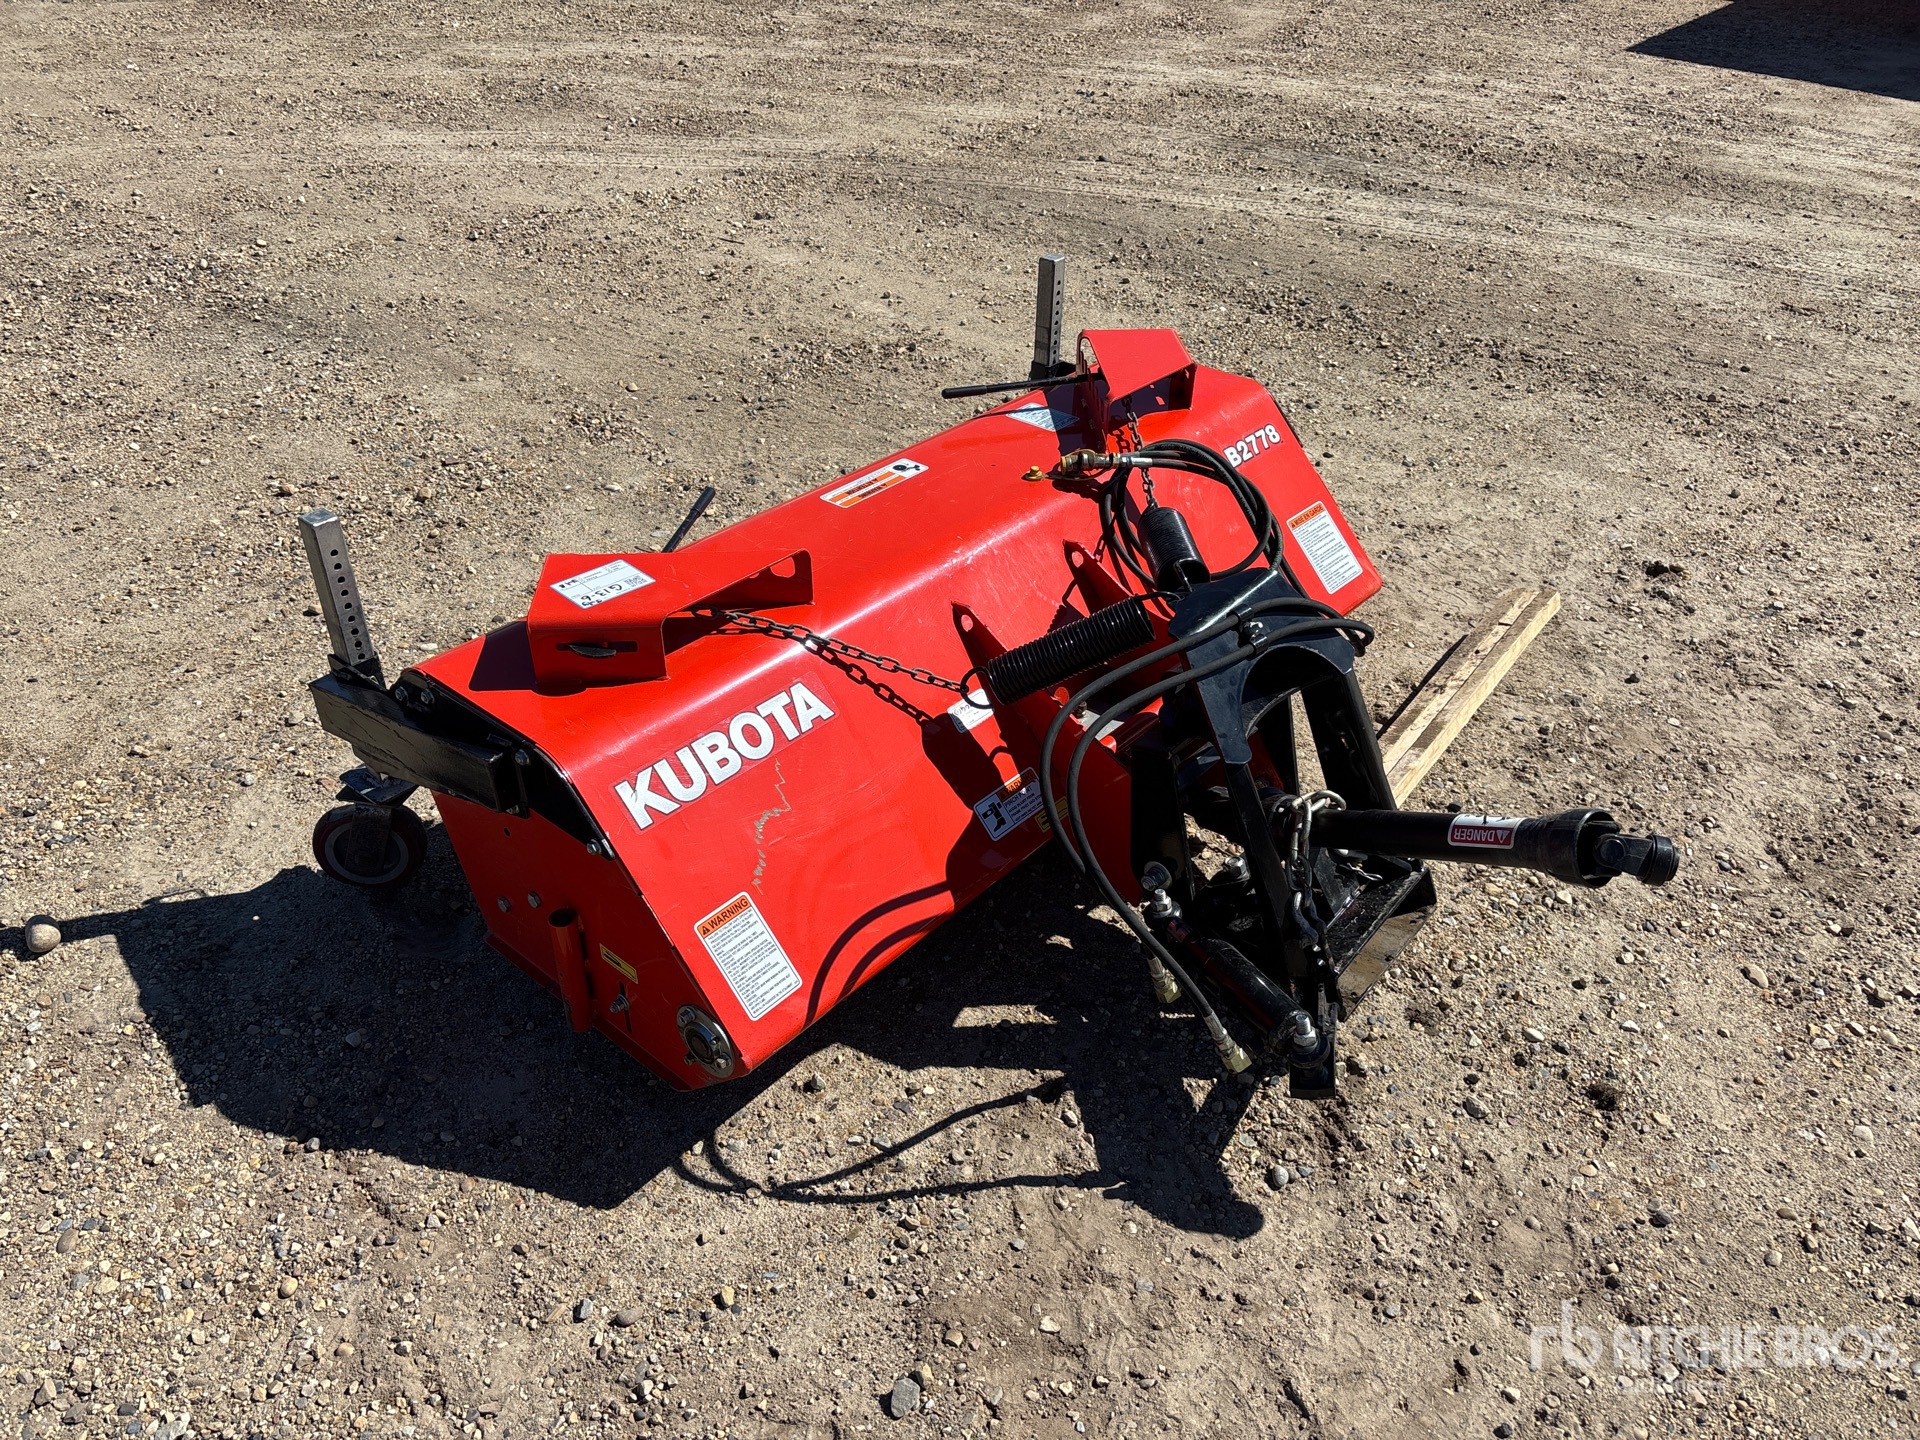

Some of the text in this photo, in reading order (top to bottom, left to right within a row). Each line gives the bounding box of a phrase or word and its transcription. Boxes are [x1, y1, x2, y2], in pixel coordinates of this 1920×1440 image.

[1224, 424, 1281, 467] B2778
[613, 682, 835, 830] KUBOTA
[1454, 828, 1495, 841] DANGER
[708, 898, 748, 930] WARNING
